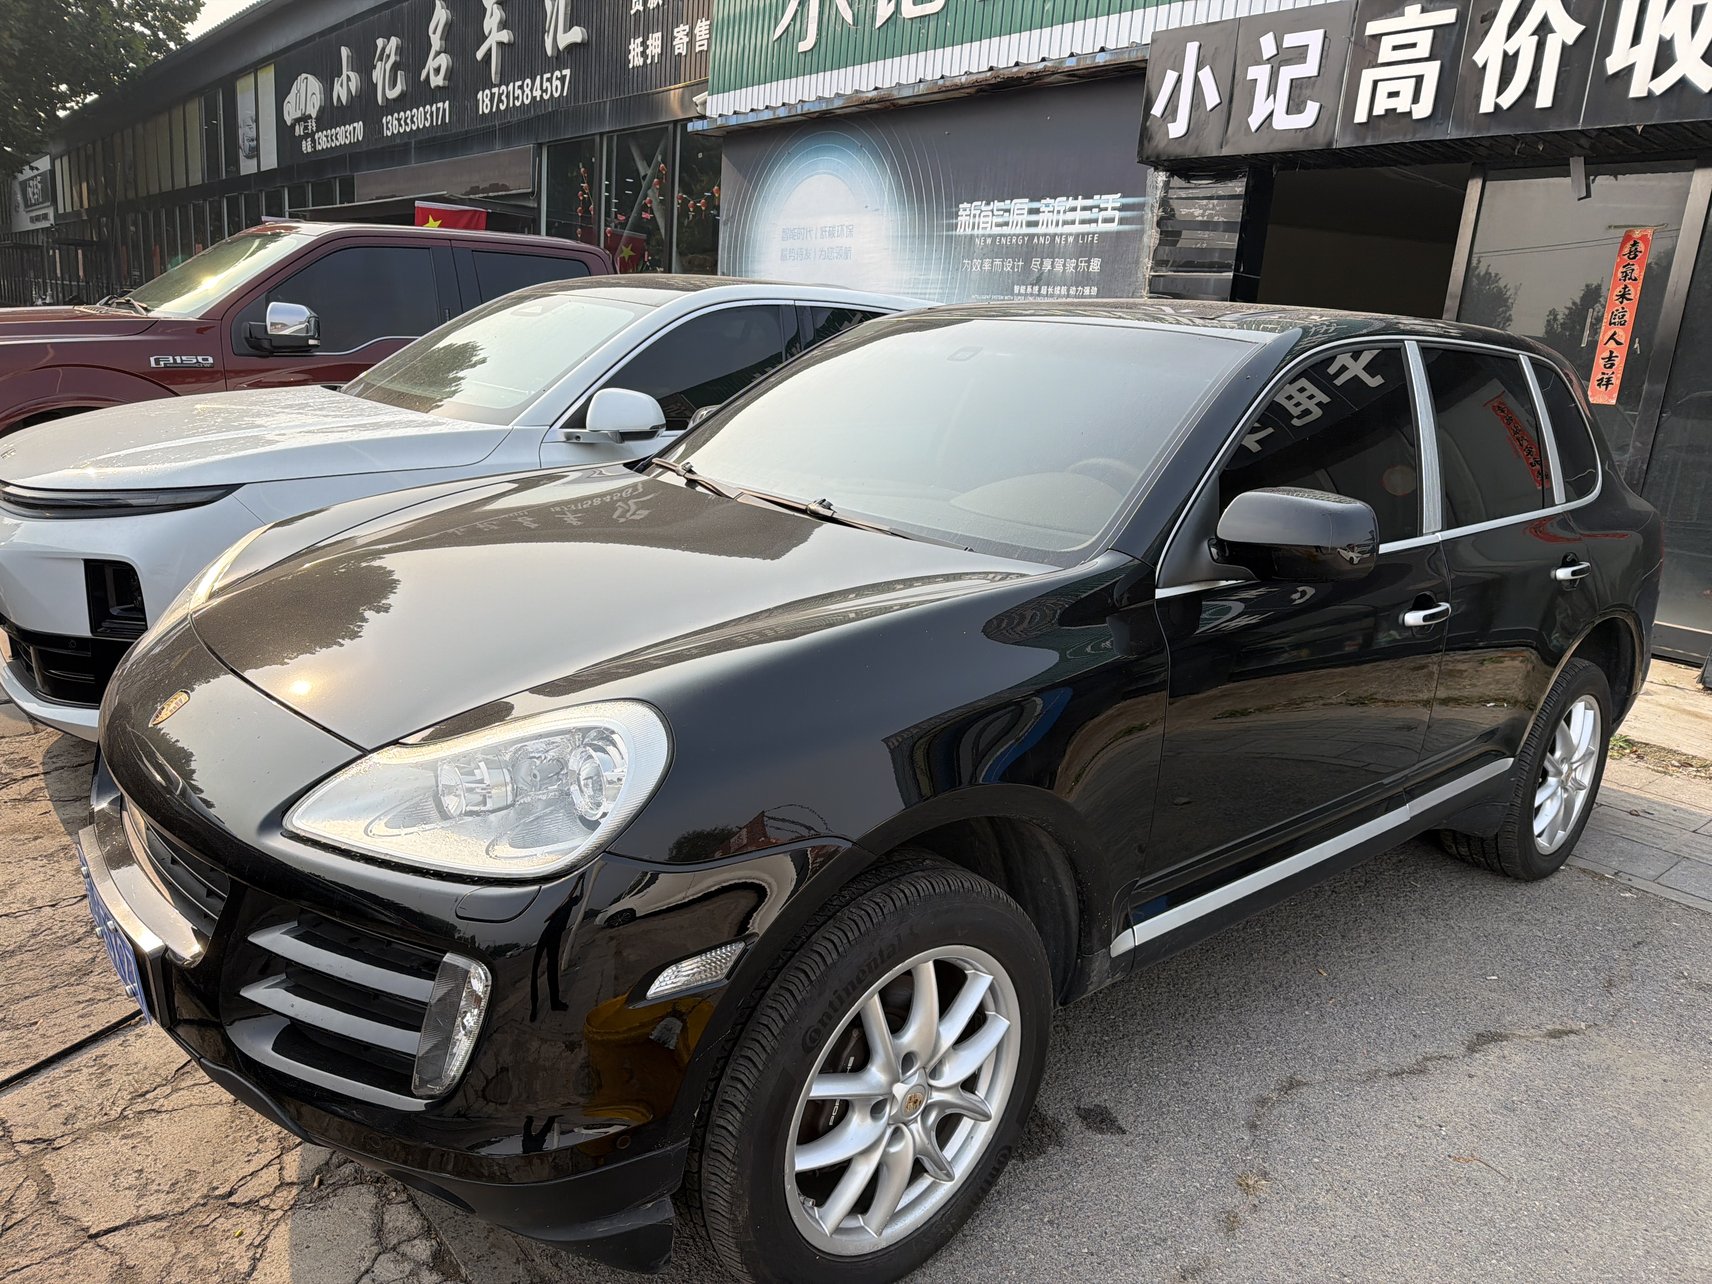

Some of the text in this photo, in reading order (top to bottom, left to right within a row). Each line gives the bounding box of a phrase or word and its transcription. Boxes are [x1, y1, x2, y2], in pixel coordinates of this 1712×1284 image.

[628, 17, 711, 69] 抵押 寄售
[477, 69, 571, 115] 18731584567
[315, 121, 364, 151] 13633303170
[382, 101, 450, 137] 13633303171
[957, 193, 1121, 232] 新能源 新生活
[975, 234, 1099, 246] NEW ENERGY AND NEW LIFE
[962, 257, 1102, 273] 为效率而设计 尽享驾驶乐趣
